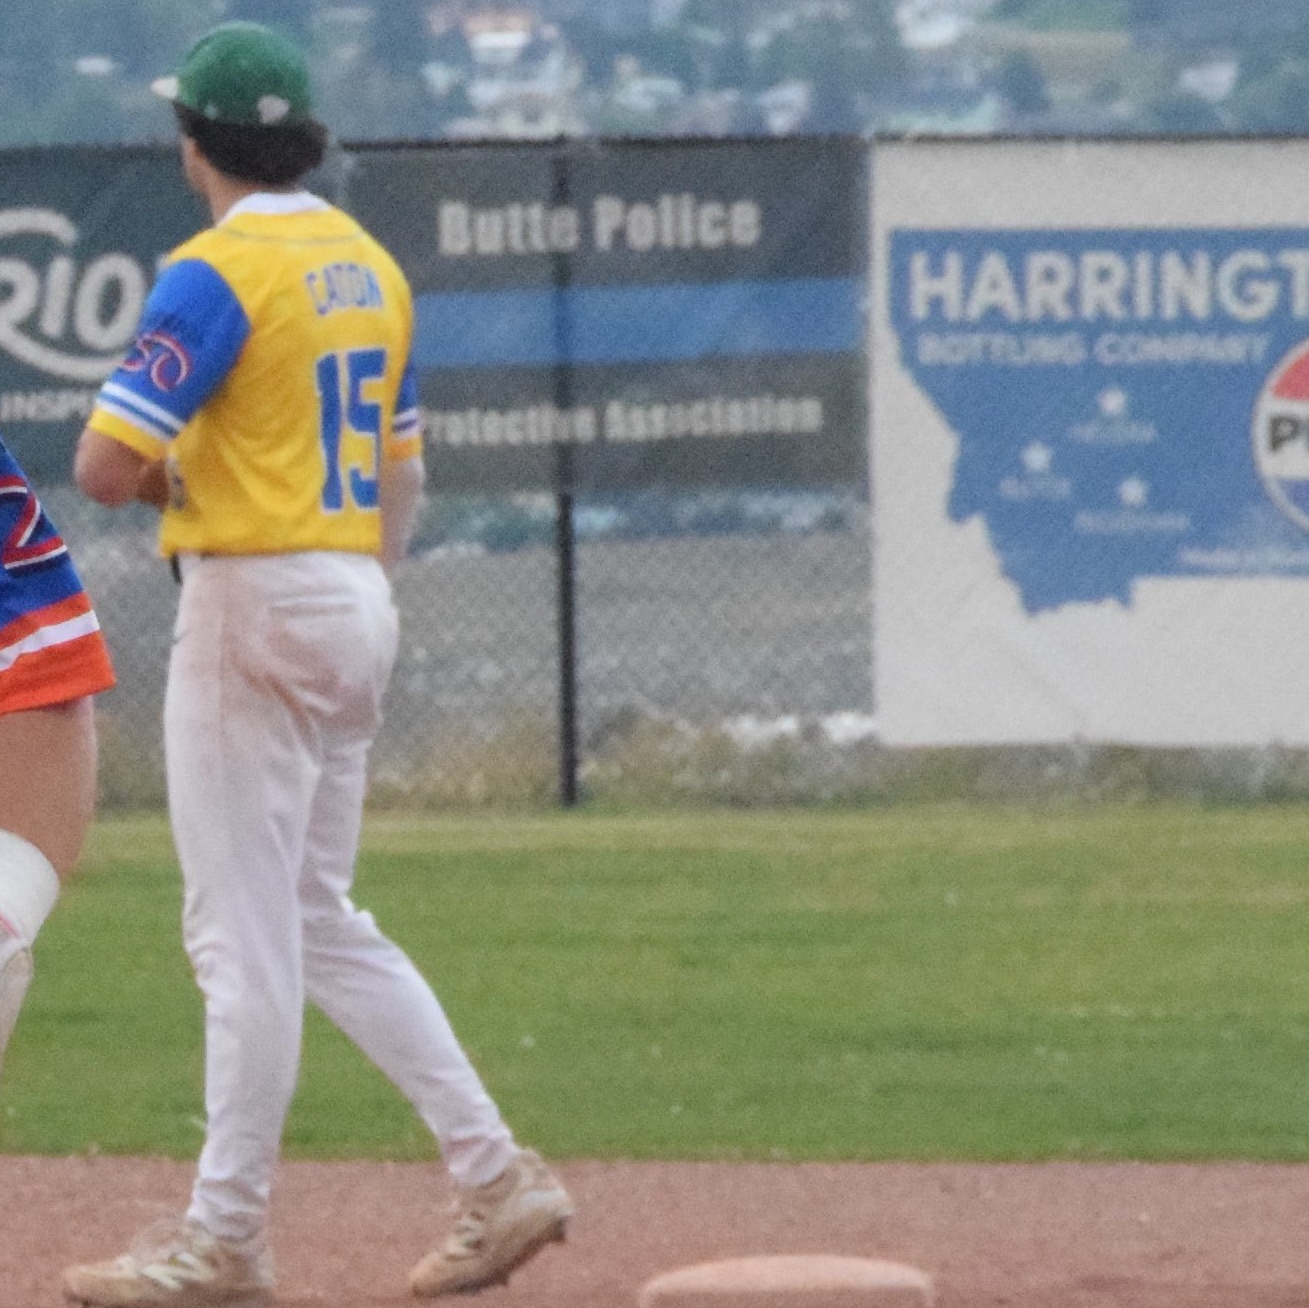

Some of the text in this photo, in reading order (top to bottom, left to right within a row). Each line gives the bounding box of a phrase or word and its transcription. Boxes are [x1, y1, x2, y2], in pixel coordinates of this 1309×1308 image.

[438, 193, 762, 256] Butte Police
[1093, 332, 1272, 366] COMPANY
[314, 347, 388, 514] 15
[424, 402, 598, 447] rotective
